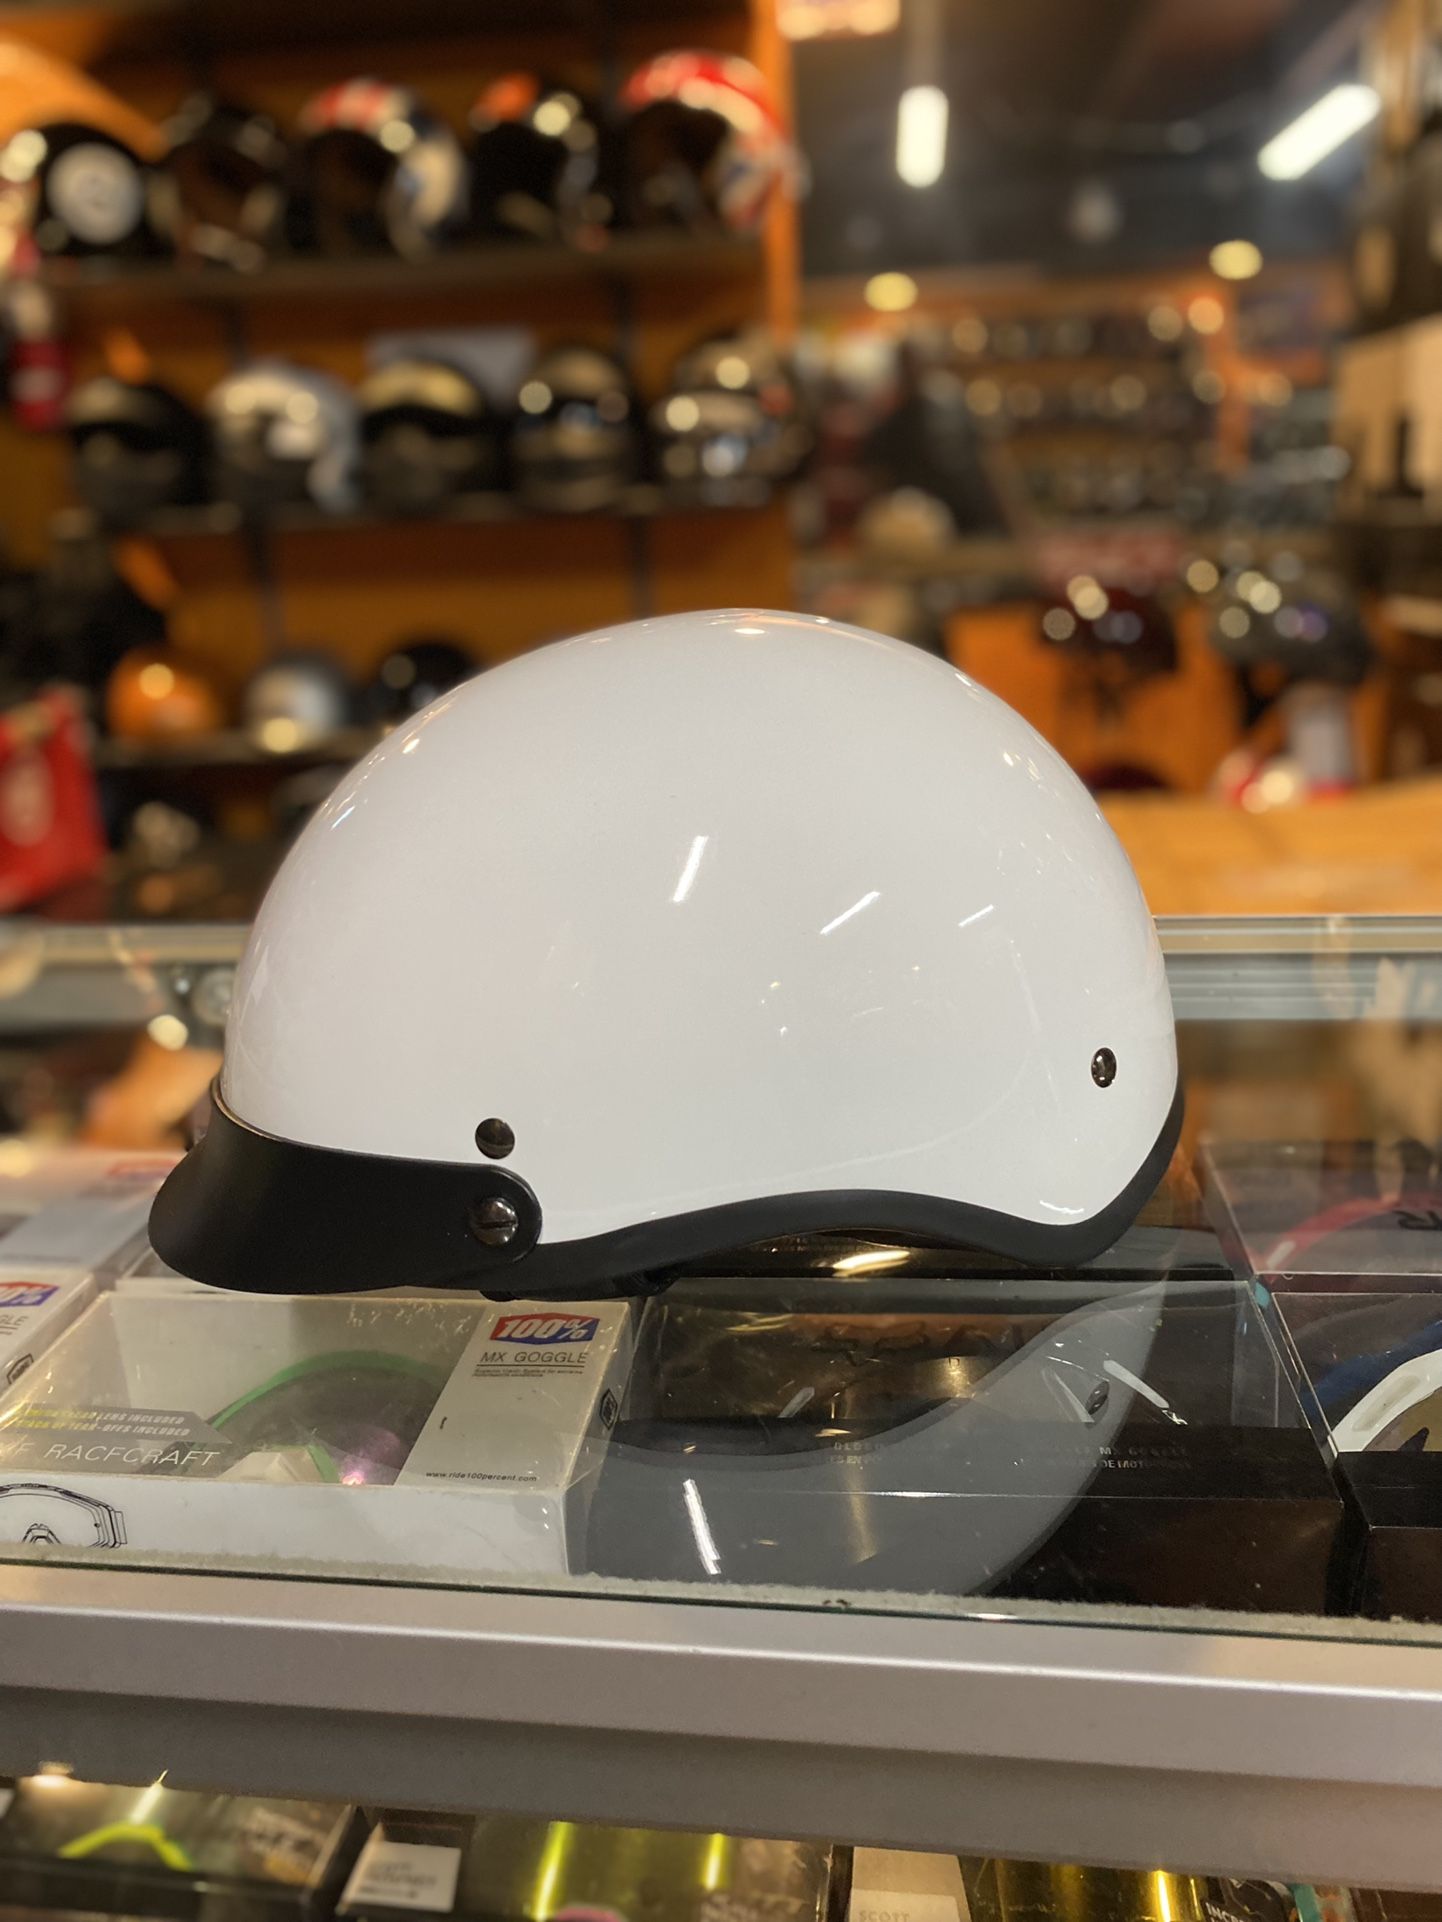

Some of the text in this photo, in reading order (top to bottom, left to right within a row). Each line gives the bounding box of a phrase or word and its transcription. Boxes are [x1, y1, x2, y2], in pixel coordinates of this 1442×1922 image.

[497, 1318, 593, 1340] 100%
[480, 1351, 590, 1364] MX GOGGLE
[128, 1413, 185, 1425] INCLUDED
[132, 1424, 191, 1436] INCLUDED
